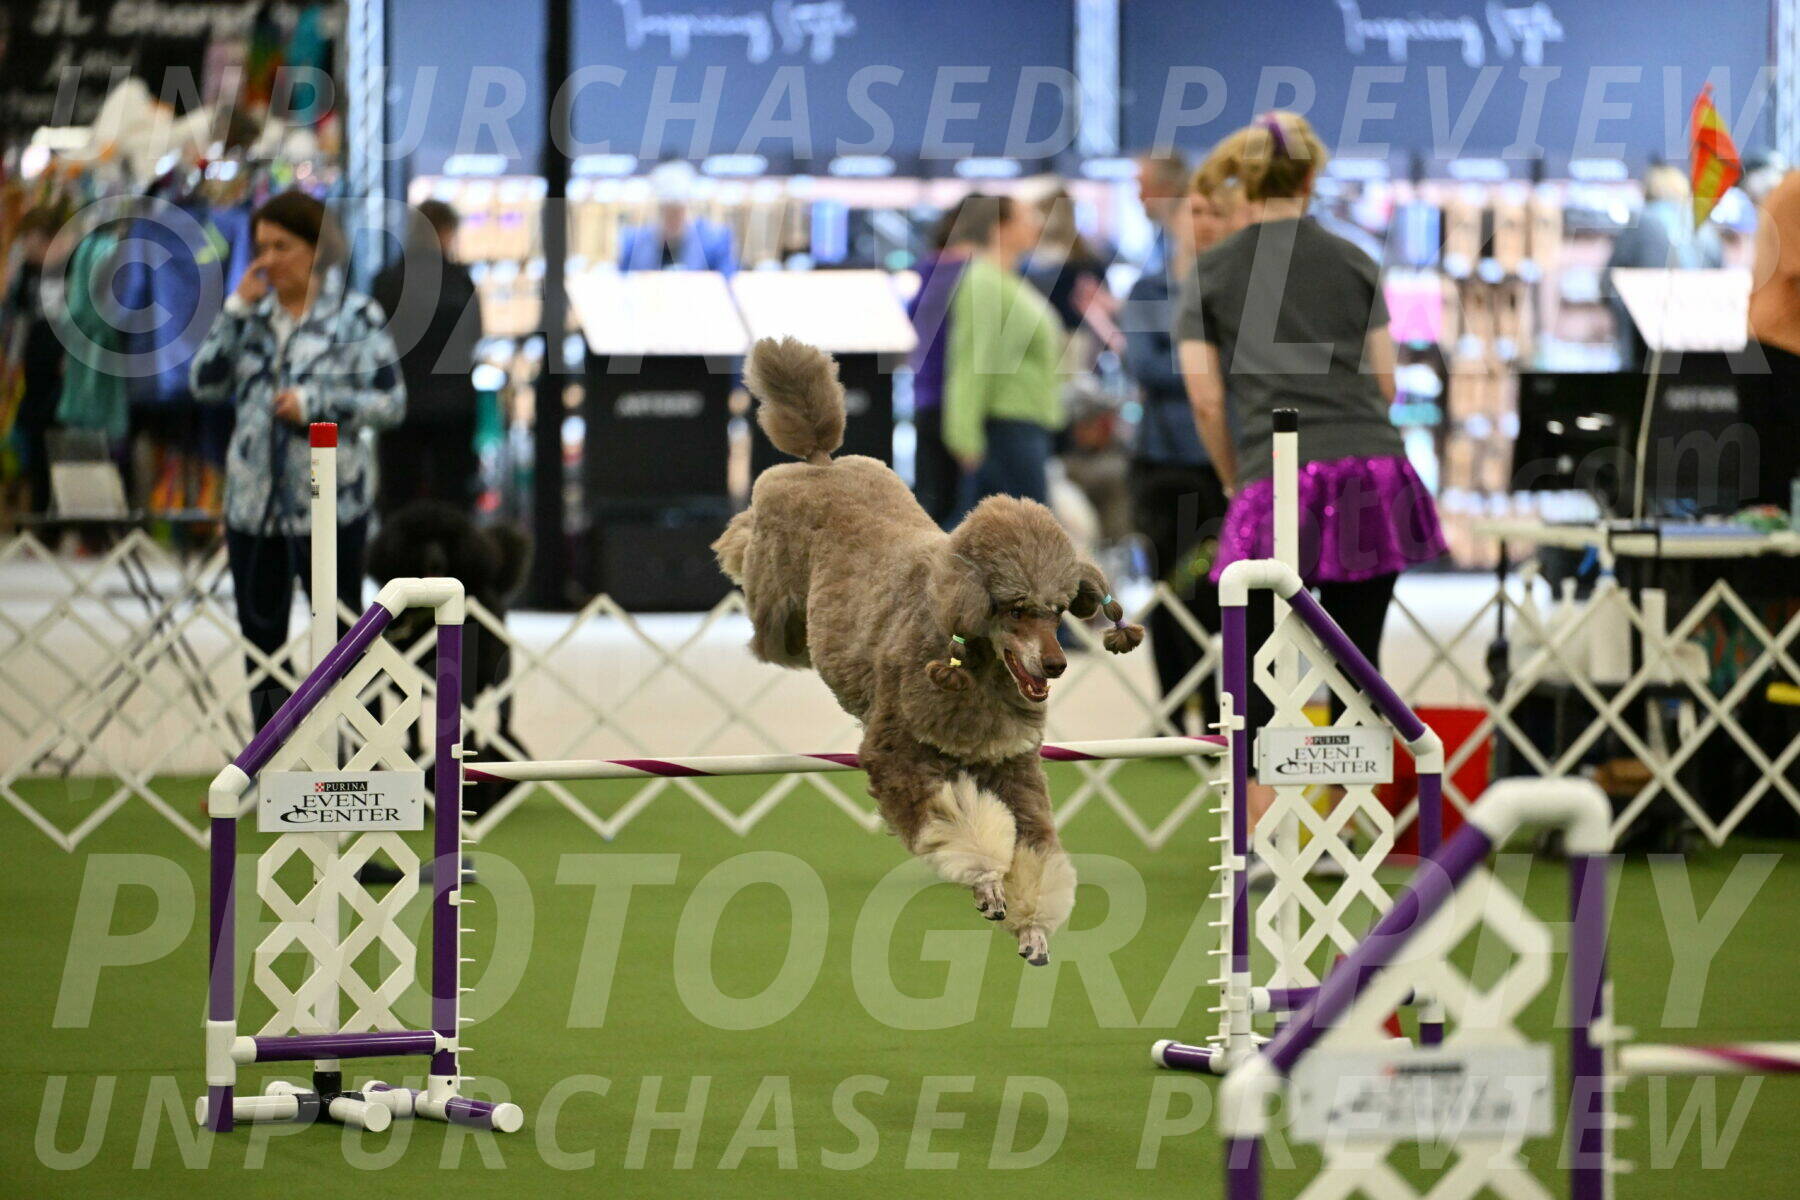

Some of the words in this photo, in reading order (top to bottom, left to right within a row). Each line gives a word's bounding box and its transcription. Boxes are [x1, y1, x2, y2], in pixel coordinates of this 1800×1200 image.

[1313, 736, 1349, 744] PURINA
[1294, 746, 1364, 759] EVENT
[1275, 759, 1377, 775] CENTER
[326, 783, 366, 791] PURINA
[303, 793, 384, 807] EVENT
[280, 807, 401, 823] CENTER
